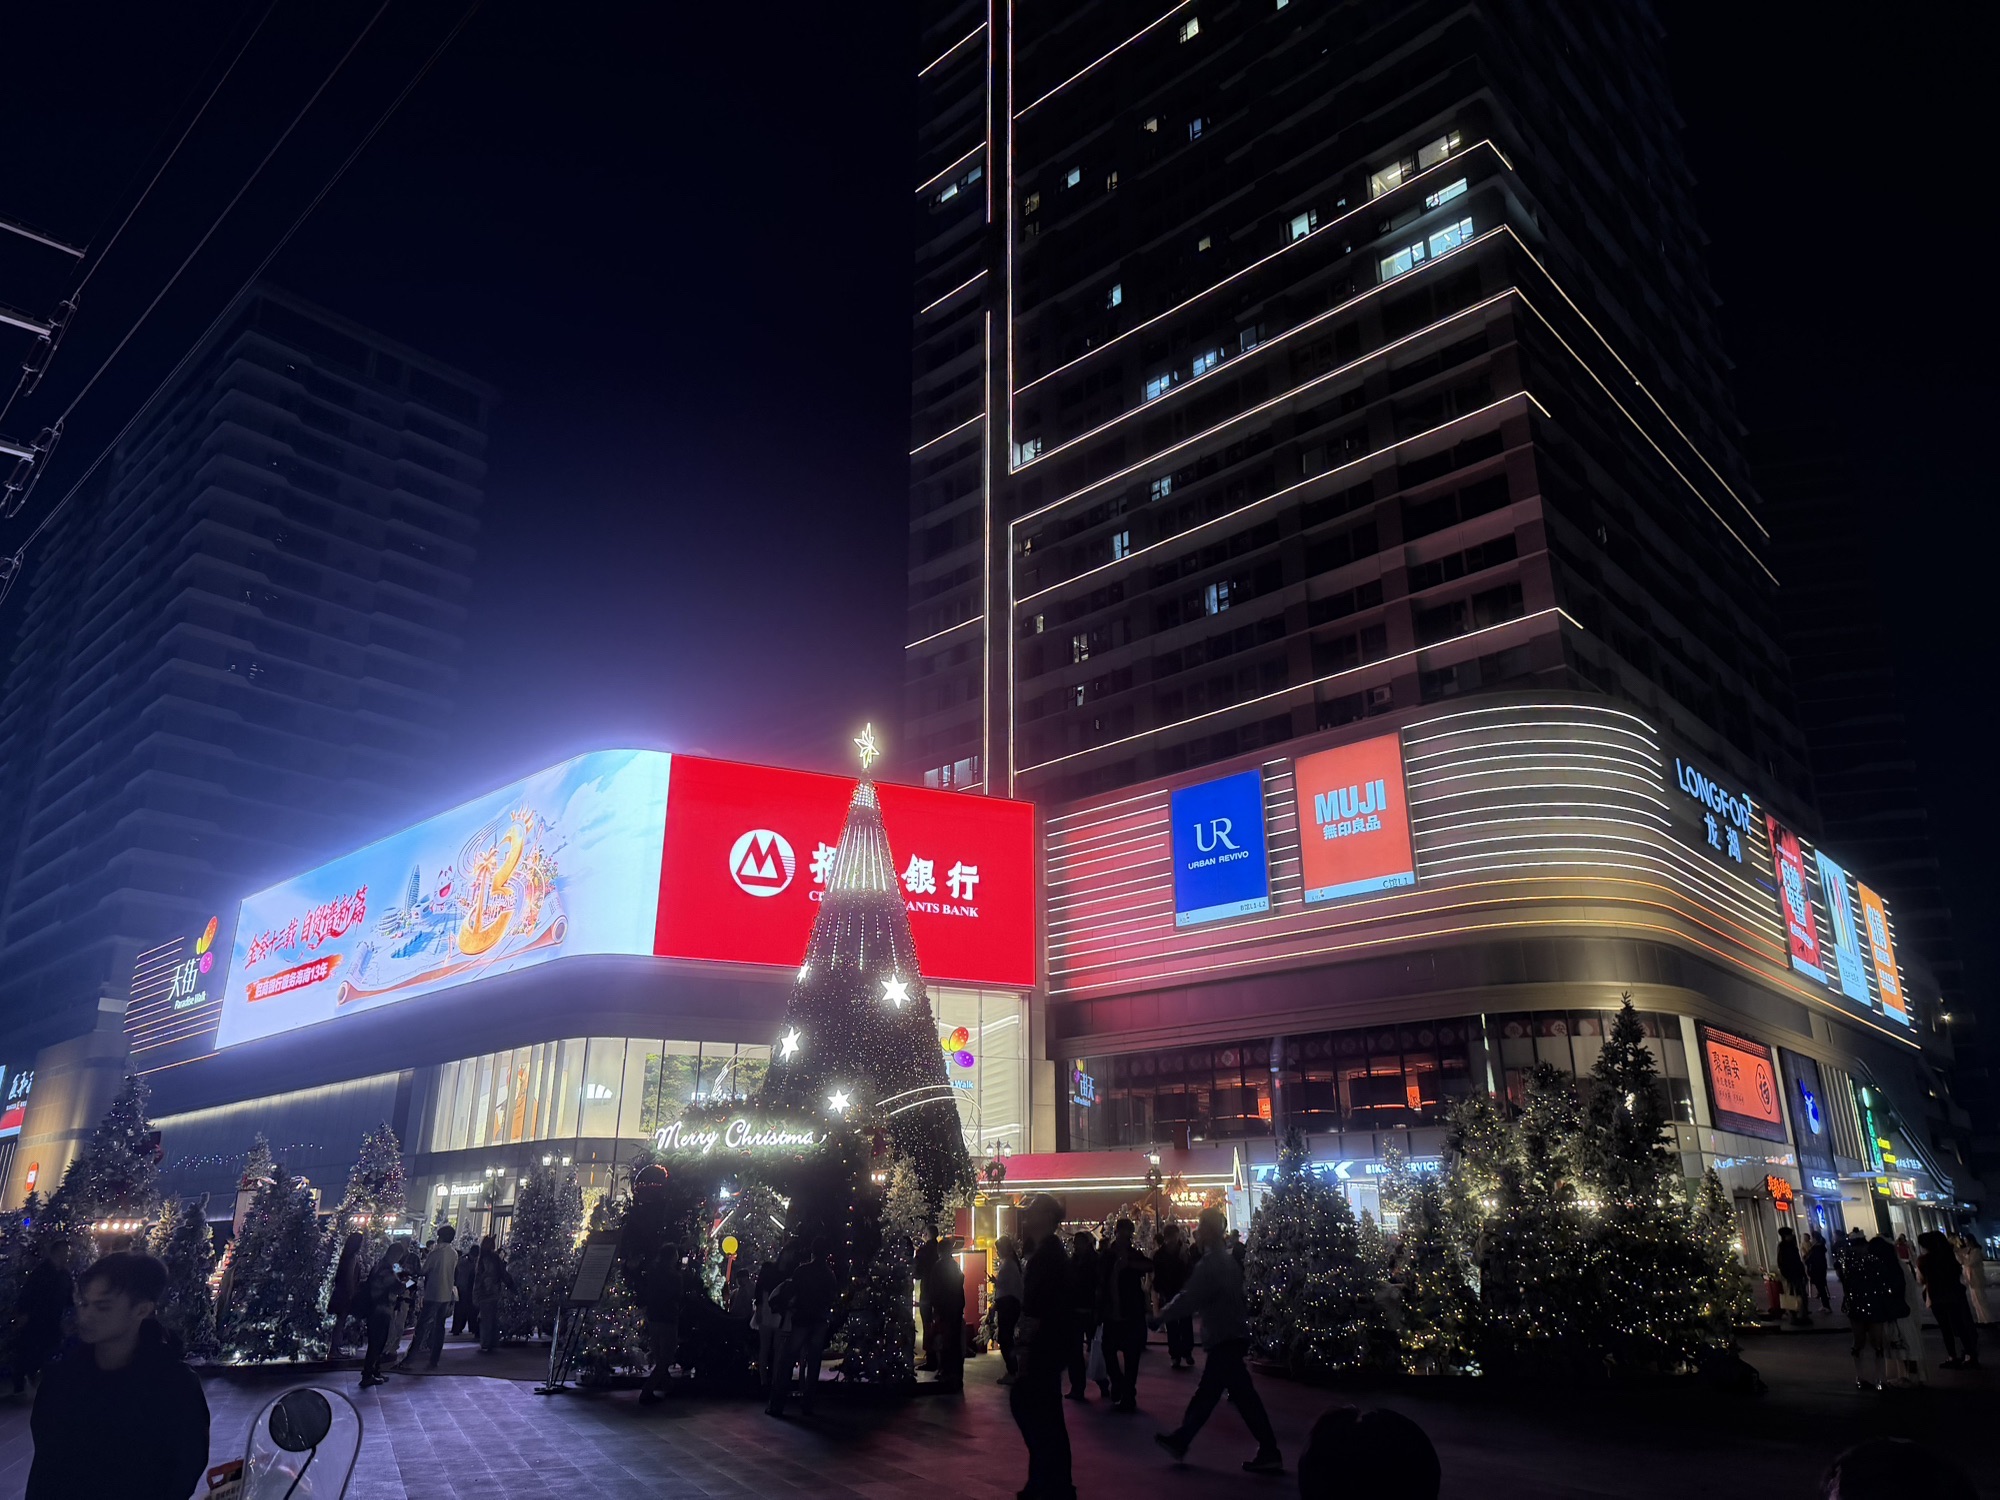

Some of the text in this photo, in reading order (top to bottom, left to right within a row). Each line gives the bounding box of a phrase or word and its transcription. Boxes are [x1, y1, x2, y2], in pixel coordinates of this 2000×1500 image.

[1314, 779, 1388, 825] MUJI
[1676, 757, 1752, 836] LONGFOR
[1193, 817, 1241, 852] UR
[1323, 815, 1382, 840] 無印良品
[1704, 812, 1742, 863] 龙湖
[1188, 850, 1250, 870] URBAN REVIVO
[942, 904, 979, 918] BANK
[168, 958, 201, 1001] 天街
[174, 991, 206, 1010] Paradise Walk
[953, 1080, 974, 1090] Walk
[655, 1121, 720, 1155] Merry
